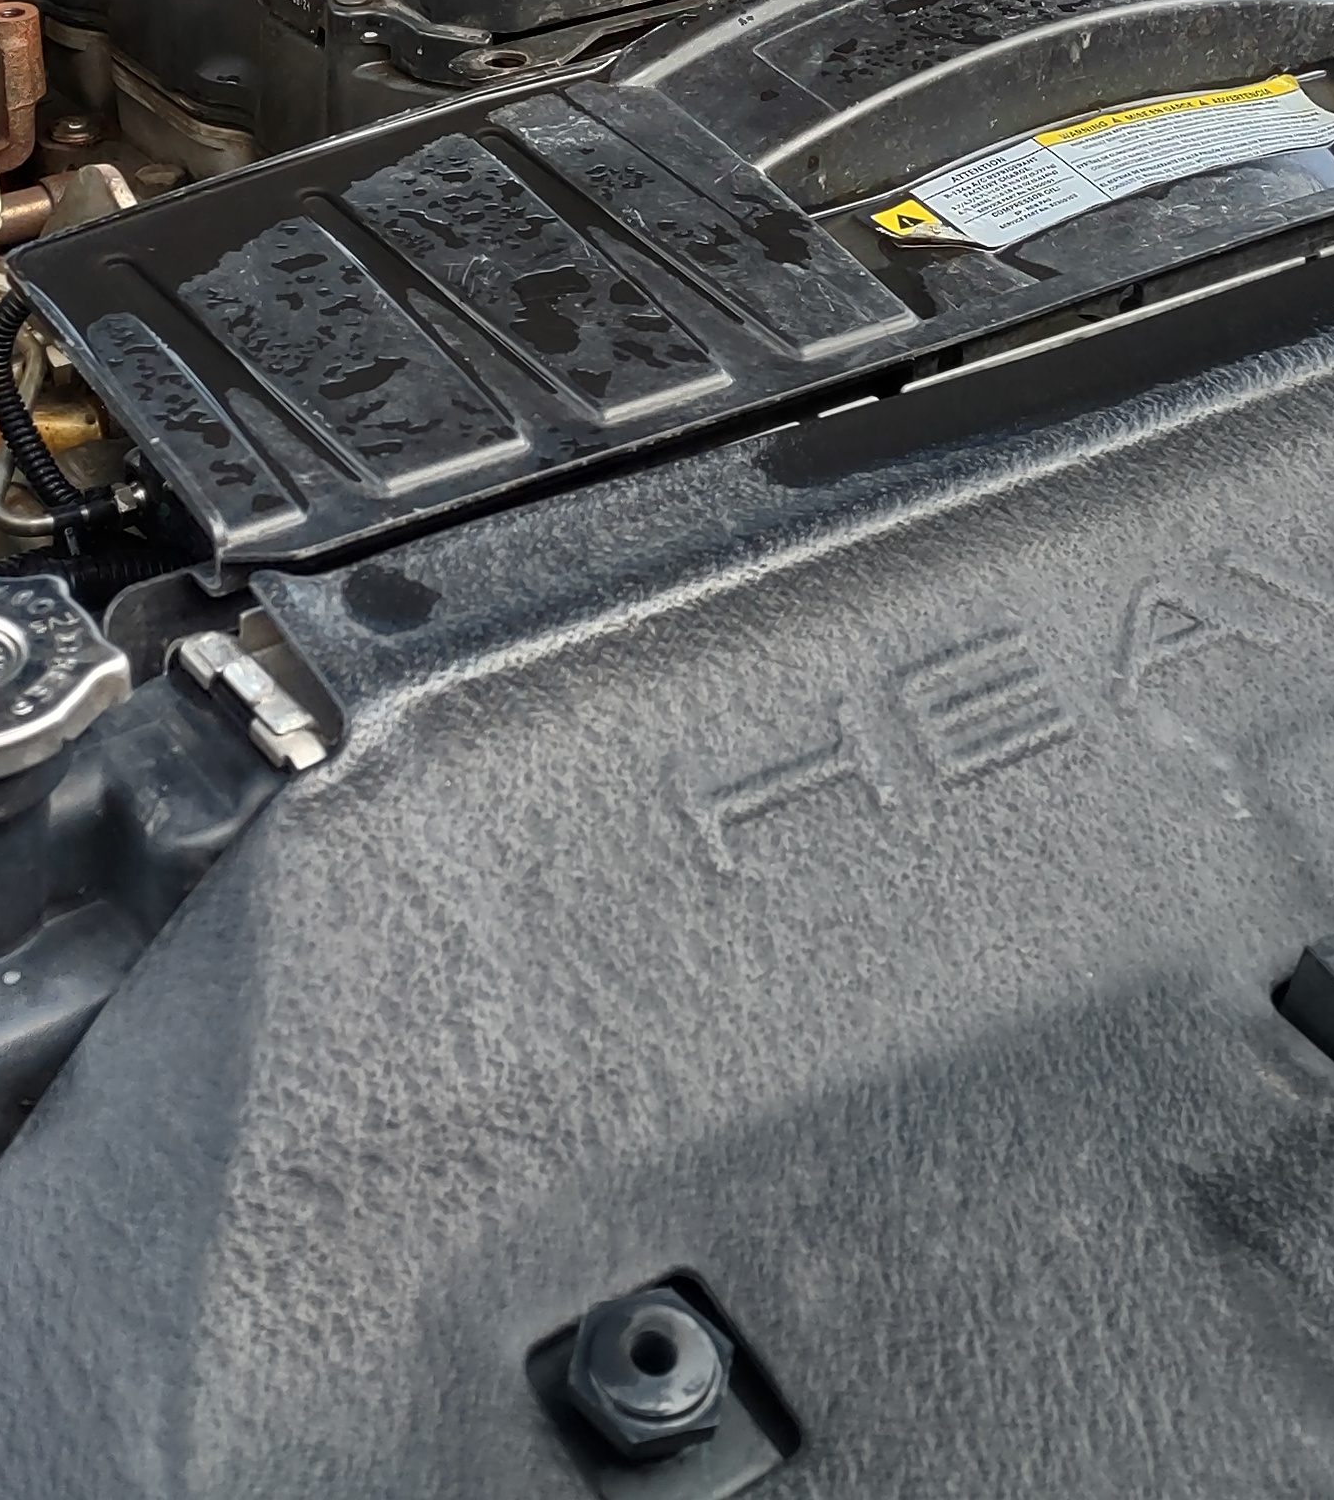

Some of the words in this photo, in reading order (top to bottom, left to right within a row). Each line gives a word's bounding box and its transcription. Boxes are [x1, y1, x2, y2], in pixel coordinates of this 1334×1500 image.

[1059, 120, 1108, 139] WARNING
[950, 156, 1007, 184] ATTENTION
[986, 156, 1038, 180] REFRIGERANT
[963, 179, 998, 197] FACTORY
[991, 191, 1044, 217] COMPRESSOR
